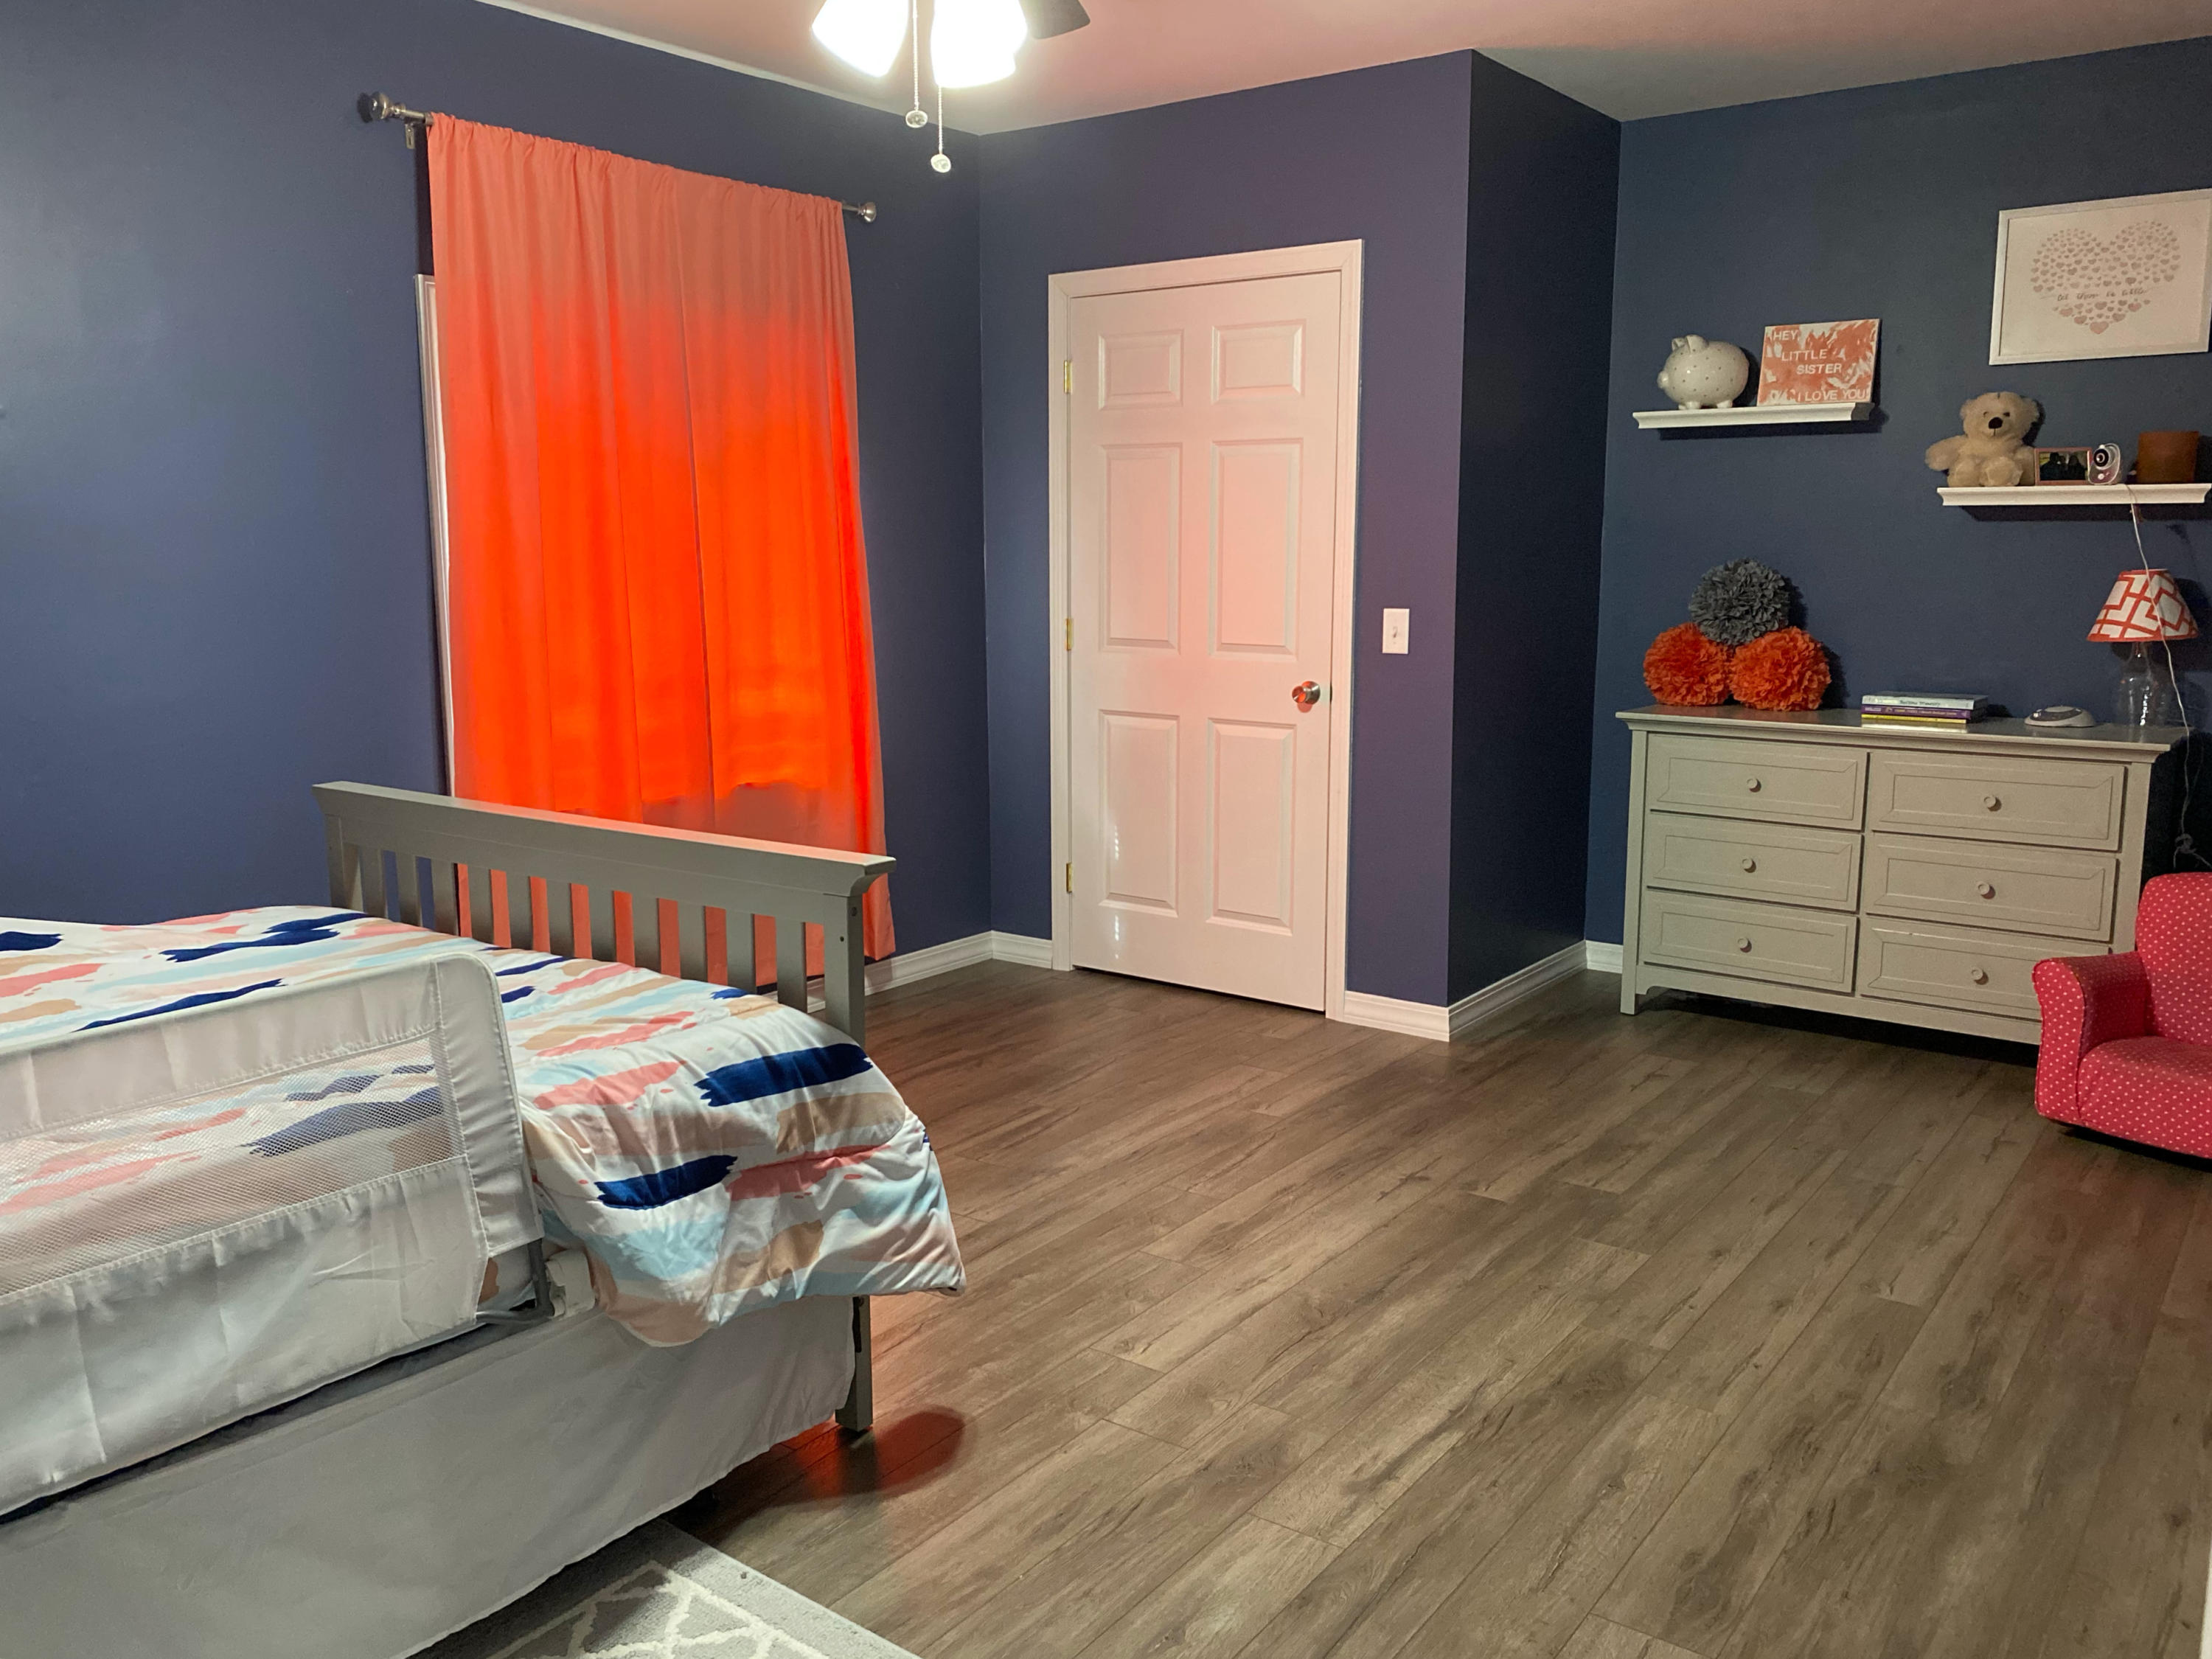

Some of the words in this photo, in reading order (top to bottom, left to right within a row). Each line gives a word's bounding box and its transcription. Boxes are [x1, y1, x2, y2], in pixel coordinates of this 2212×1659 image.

[1781, 349, 1828, 361] LITTLE
[1796, 363, 1842, 375] SISTER
[1798, 392, 1801, 402] I
[1804, 389, 1838, 402] LOVE
